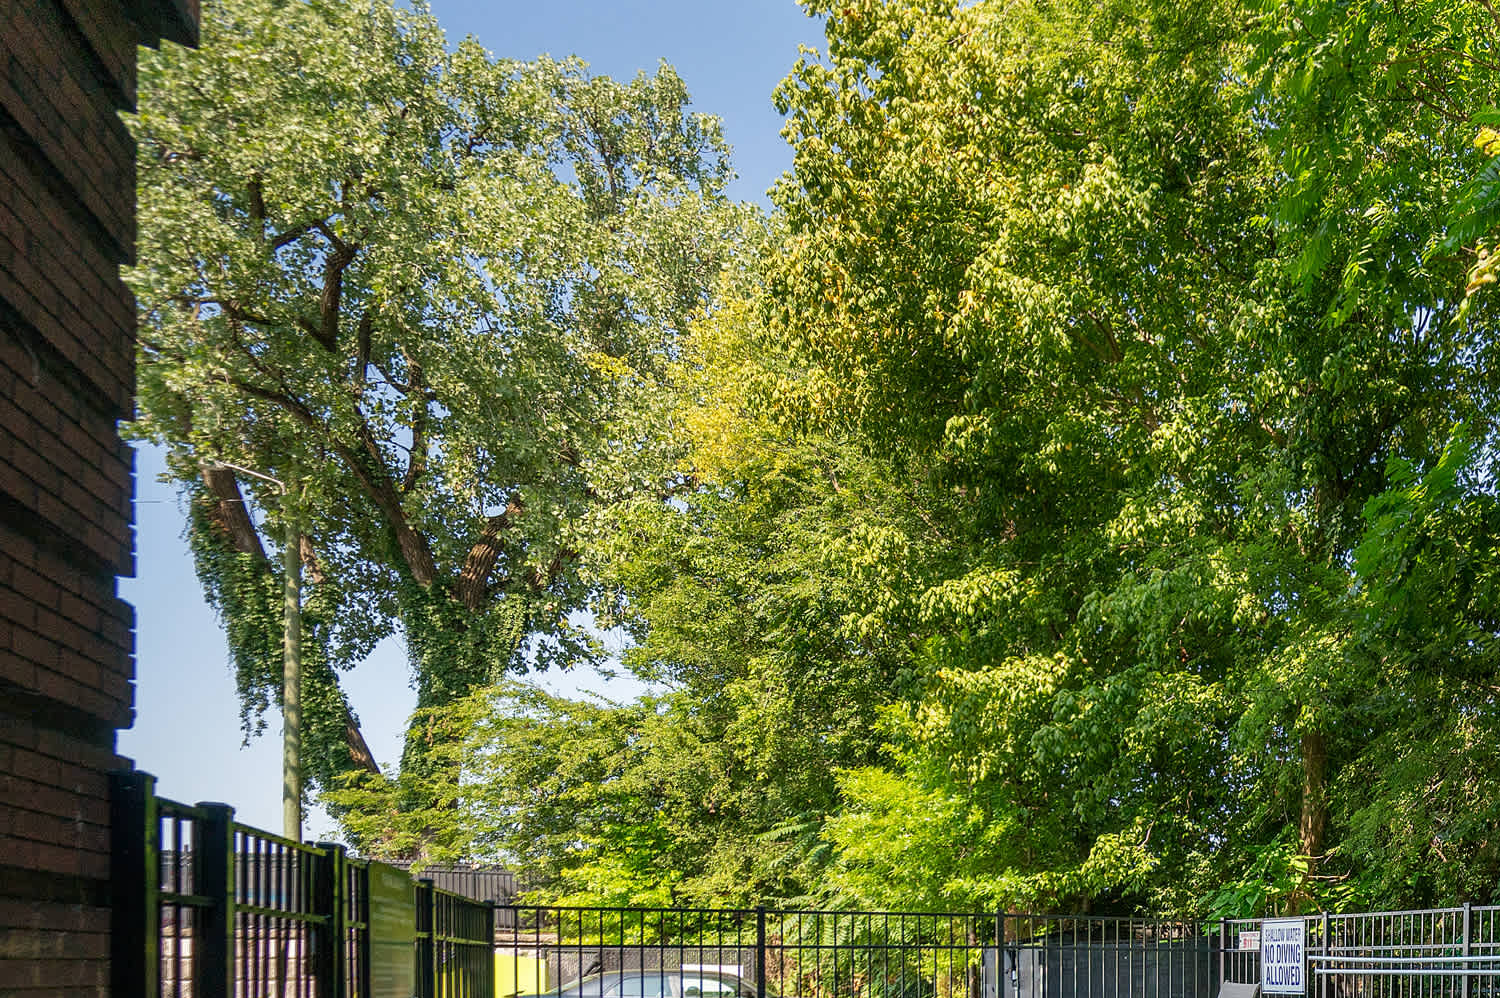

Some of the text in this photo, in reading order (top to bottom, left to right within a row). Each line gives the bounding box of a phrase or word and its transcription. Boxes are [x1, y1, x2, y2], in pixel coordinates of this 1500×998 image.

[1265, 944, 1301, 963] NO DIVING
[1266, 966, 1300, 985] ALLOWED
